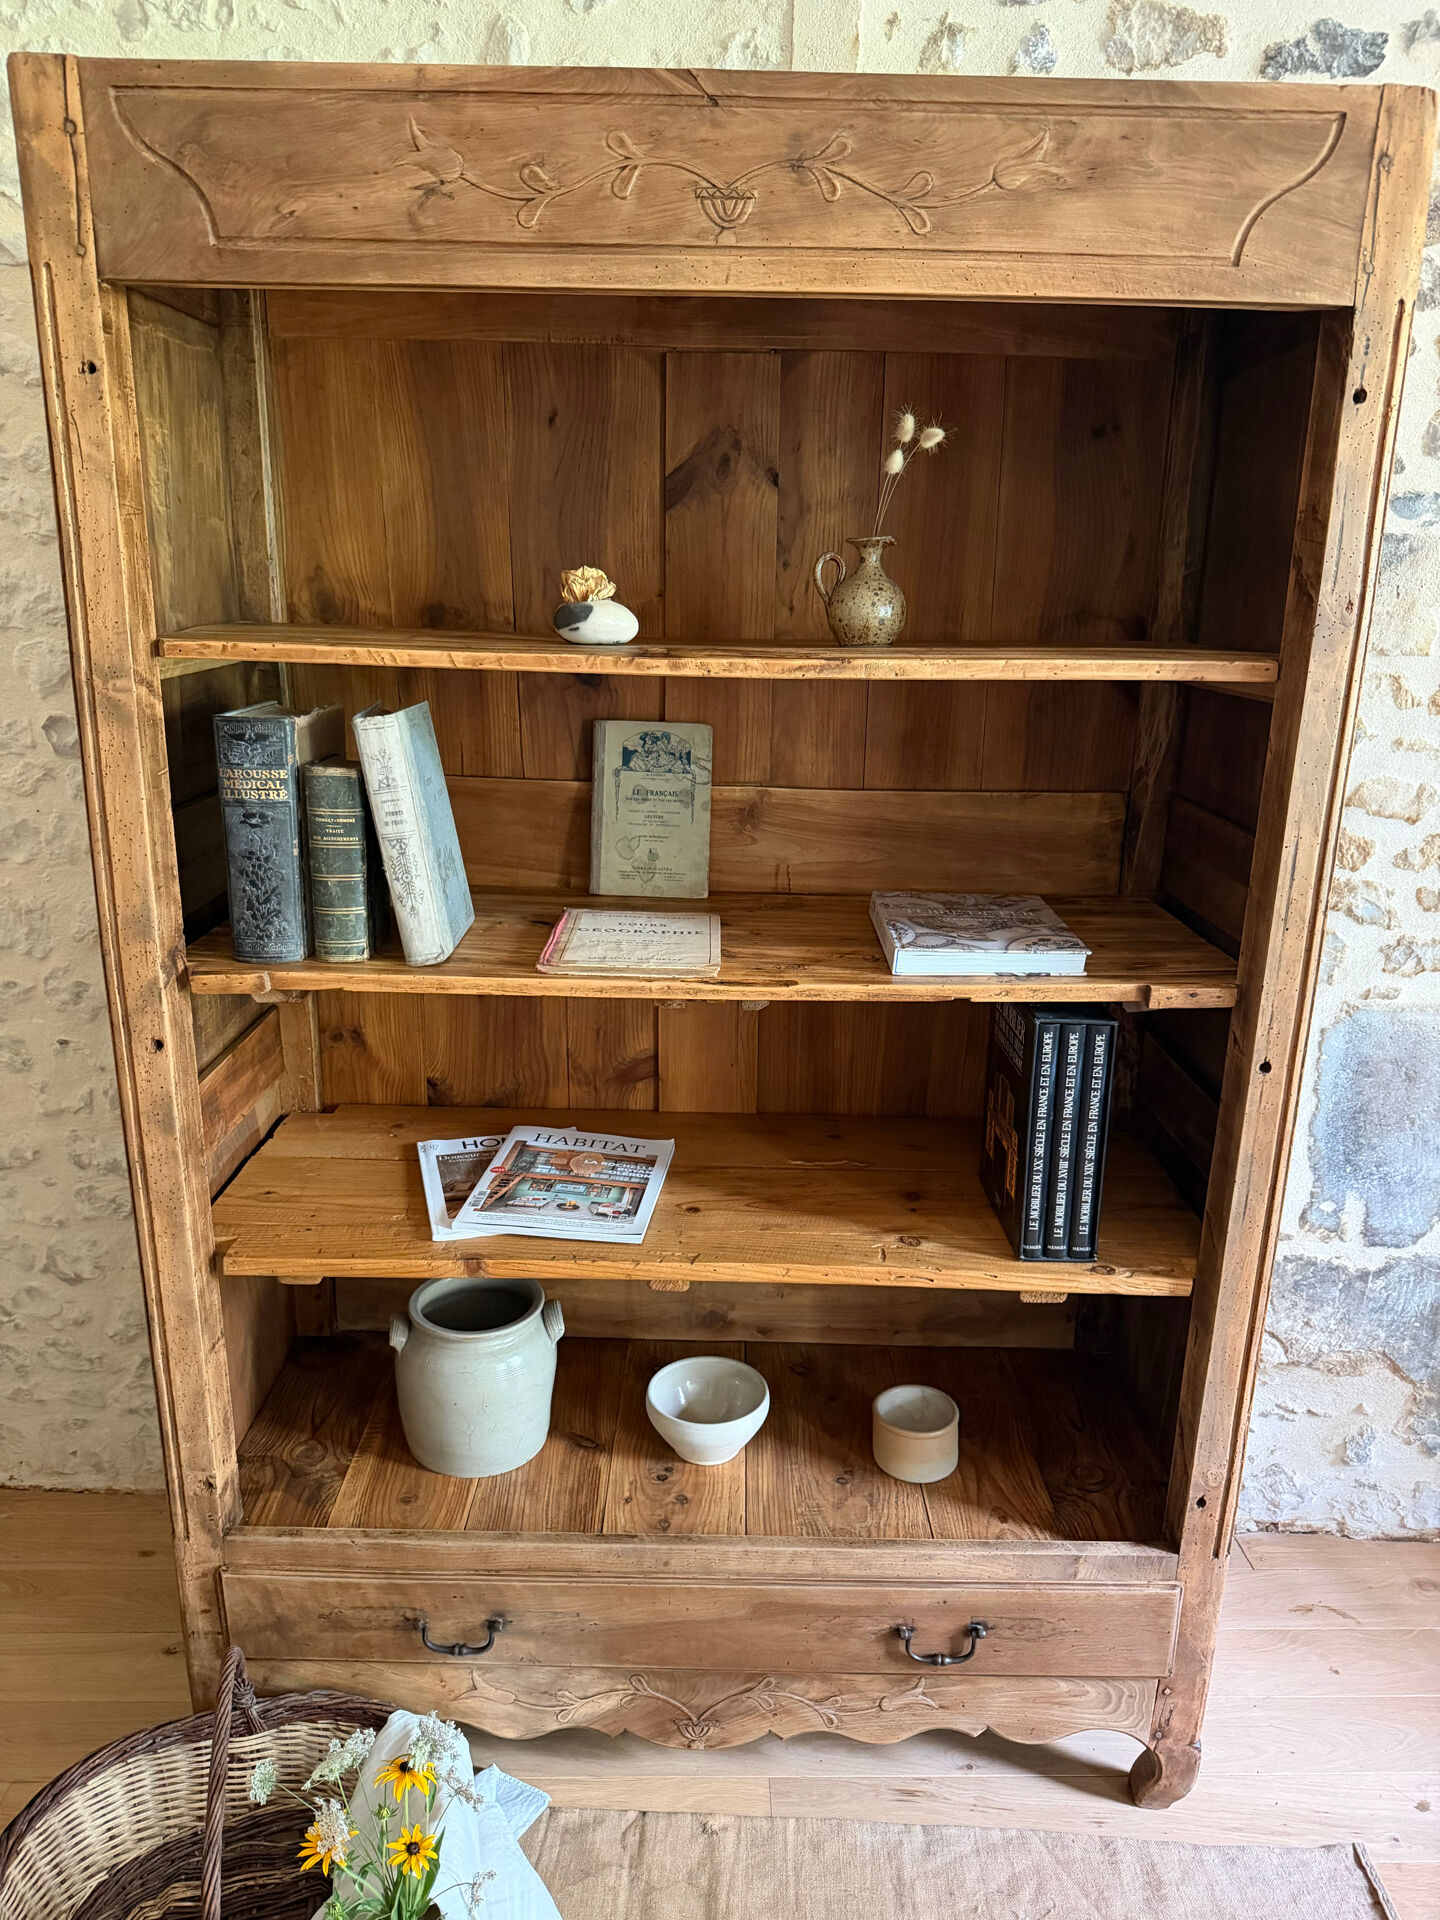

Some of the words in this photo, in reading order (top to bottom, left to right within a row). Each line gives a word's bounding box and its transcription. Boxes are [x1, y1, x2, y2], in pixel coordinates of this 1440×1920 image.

[219, 768, 288, 779] LAROUSSE
[223, 777, 285, 790] MÉDICAL
[632, 788, 641, 796] LE
[645, 789, 679, 798] FRANÇAIS
[1042, 1031, 1053, 1062] EUROPE
[1067, 1032, 1079, 1062] EUROPE
[1093, 1033, 1105, 1064] EUROPE
[1041, 1064, 1050, 1074] EN
[1066, 1065, 1076, 1075] EN
[1092, 1066, 1102, 1077] EN
[1040, 1077, 1049, 1086] ET
[1065, 1077, 1075, 1087] ET
[1091, 1078, 1101, 1088] ET
[1037, 1088, 1048, 1117] FRANCE
[1063, 1088, 1074, 1118] FRANCE
[1089, 1089, 1100, 1119] FRANCE
[1036, 1119, 1046, 1130] EN
[1062, 1120, 1071, 1130] EN
[1088, 1121, 1097, 1132] EN
[534, 1133, 646, 1153] HABITAT
[1032, 1172, 1042, 1183] DU
[1083, 1176, 1093, 1187] DU
[1057, 1179, 1067, 1190] DU
[1030, 1184, 1041, 1219] MOBILIER
[1080, 1189, 1092, 1223] MOBILIER
[1054, 1191, 1066, 1226] MOBILIER
[1029, 1220, 1038, 1230] LE
[1079, 1225, 1088, 1235] LE
[1053, 1228, 1063, 1237] LE
